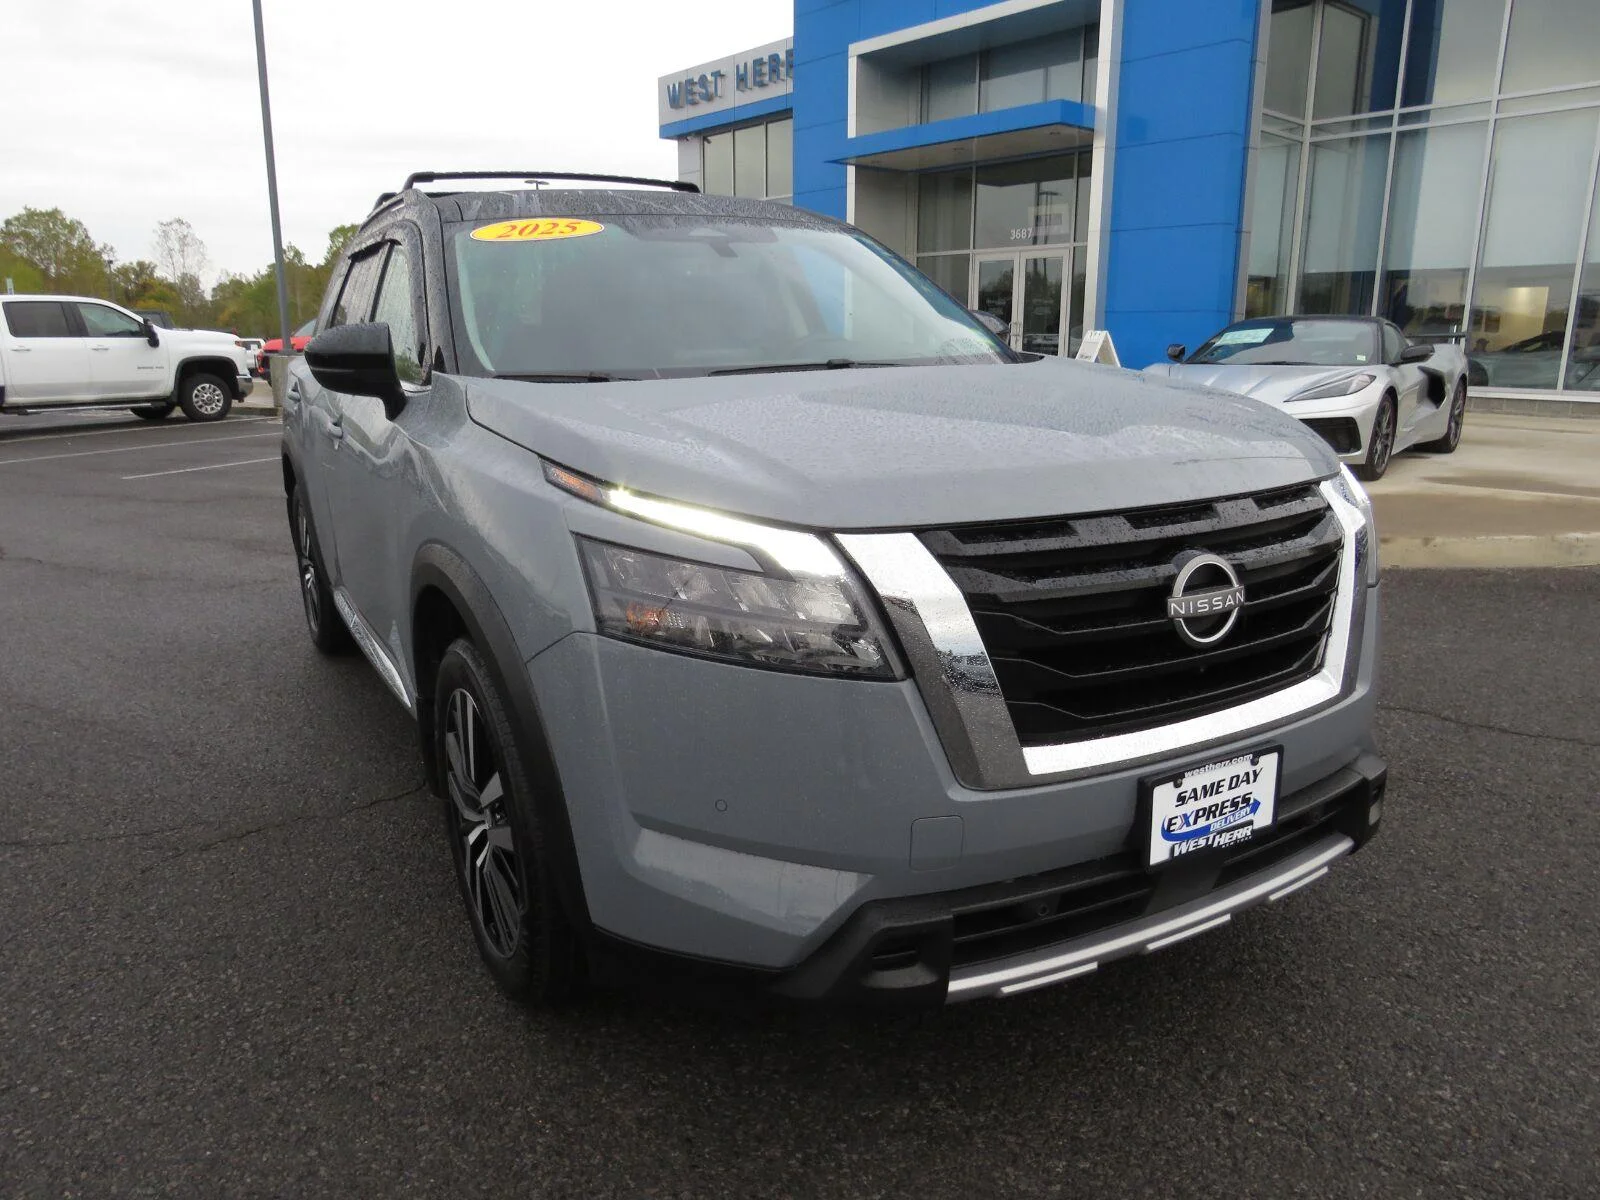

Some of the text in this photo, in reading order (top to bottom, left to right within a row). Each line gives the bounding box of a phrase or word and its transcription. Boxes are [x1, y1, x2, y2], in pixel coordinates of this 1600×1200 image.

[667, 70, 723, 109] WEST
[496, 222, 582, 238] 2025
[1010, 227, 1032, 240] 3687
[1170, 590, 1244, 615] NISSAN
[1184, 753, 1253, 778] westherr.com
[1175, 767, 1263, 807] SAME DAY
[1166, 792, 1252, 833] EXPRESS
[1210, 807, 1251, 832] DELIVERY
